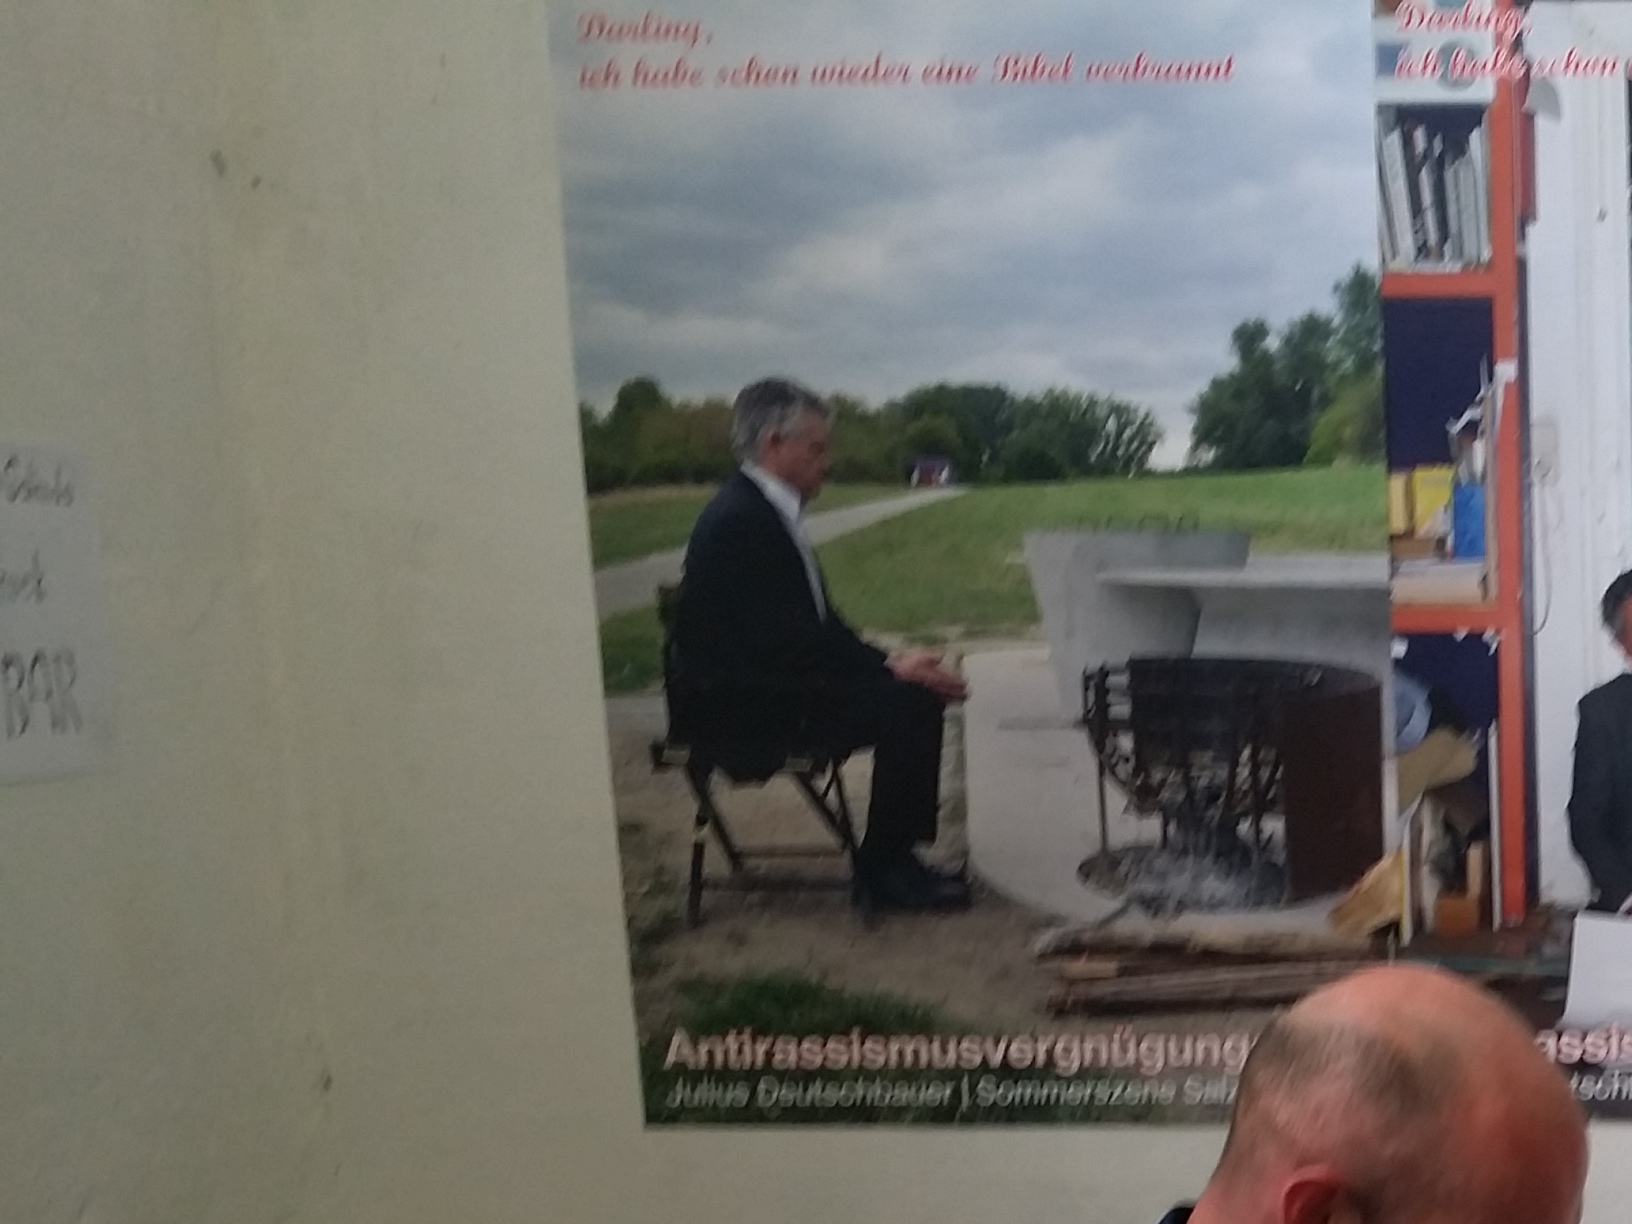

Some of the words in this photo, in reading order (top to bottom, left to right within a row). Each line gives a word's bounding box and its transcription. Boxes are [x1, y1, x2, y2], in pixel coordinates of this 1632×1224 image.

[578, 57, 622, 89] ich
[631, 57, 703, 89] habe
[714, 53, 799, 89] schon
[809, 52, 910, 88] wieder
[990, 50, 1074, 84] Bibel
[1085, 50, 1235, 84] verbrannt
[664, 1024, 1260, 1076] Antirassismusvergnügung
